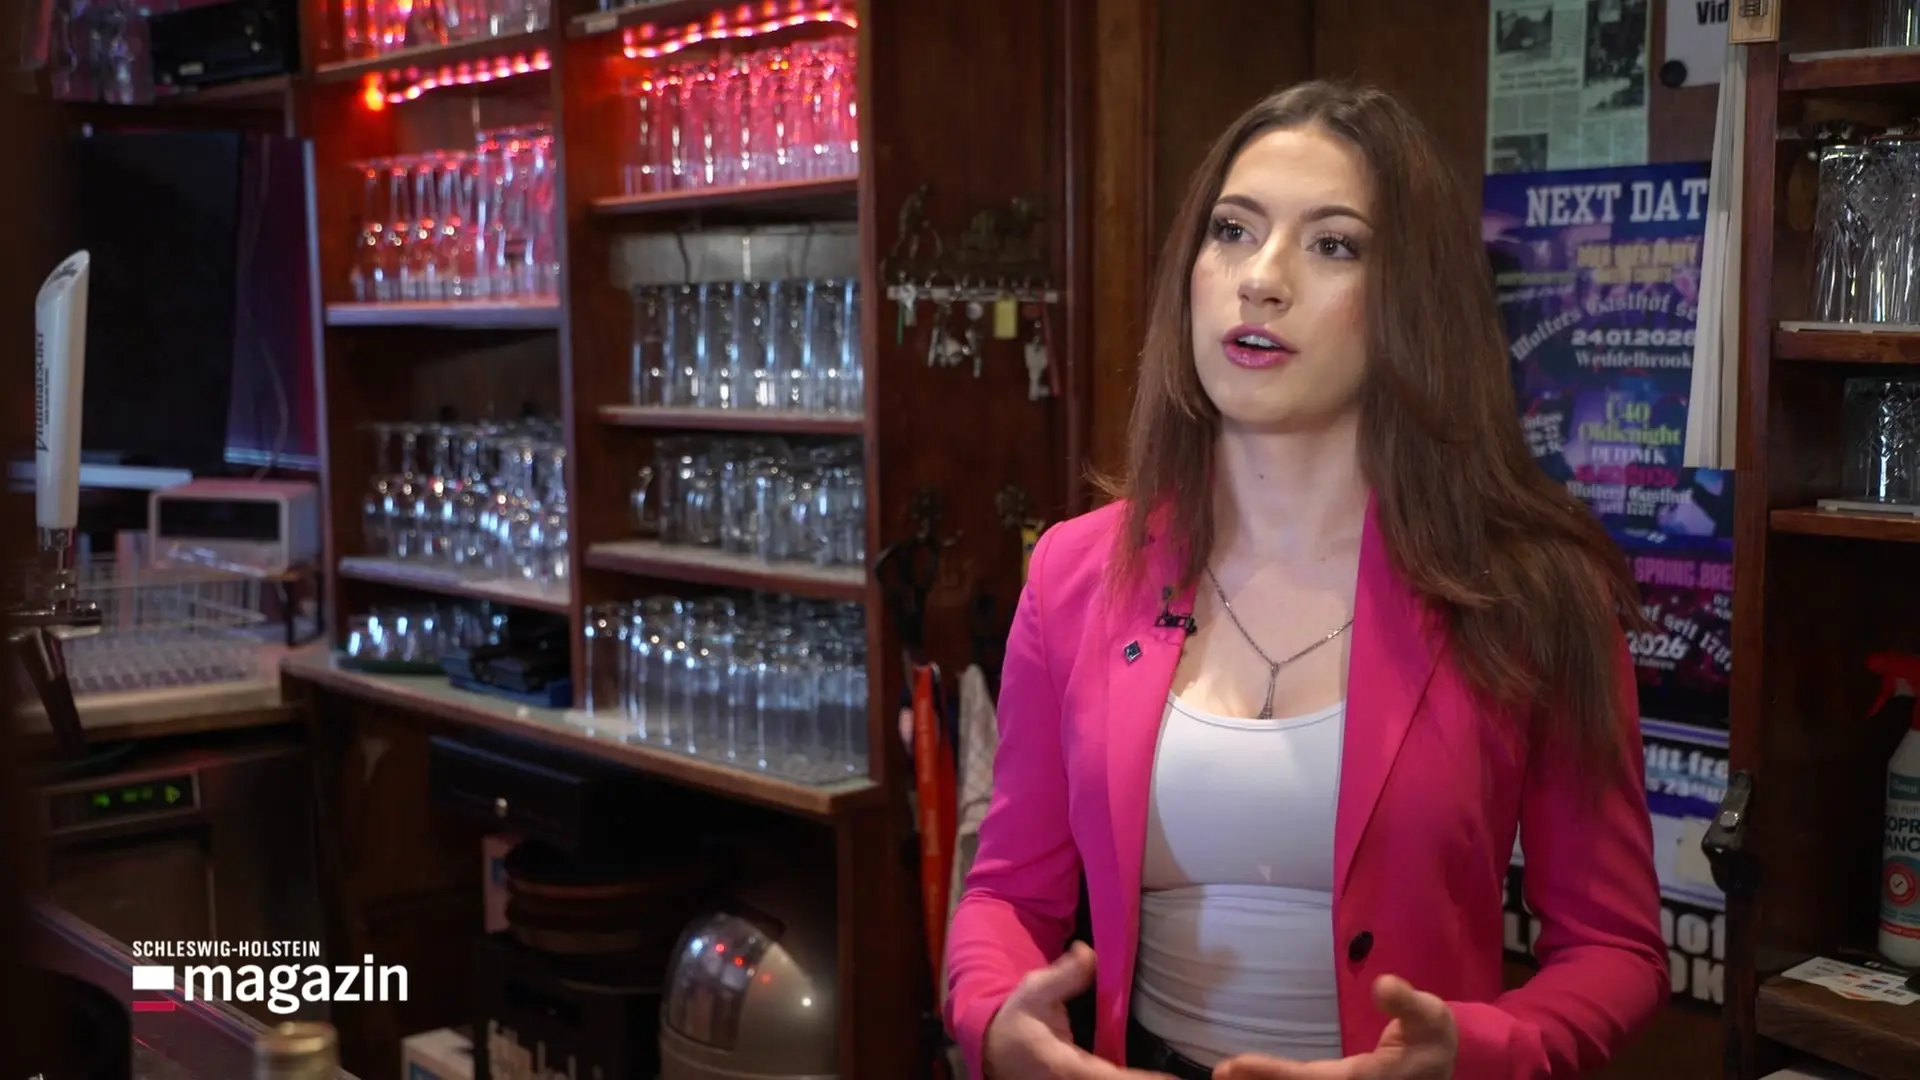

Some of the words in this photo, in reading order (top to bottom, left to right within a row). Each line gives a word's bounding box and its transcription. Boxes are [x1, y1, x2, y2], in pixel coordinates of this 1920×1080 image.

[1525, 184, 1622, 227] NEXT
[1586, 292, 1672, 318] Gasthof
[1634, 557, 1695, 587] SPRING
[1627, 630, 1690, 660] 2026
